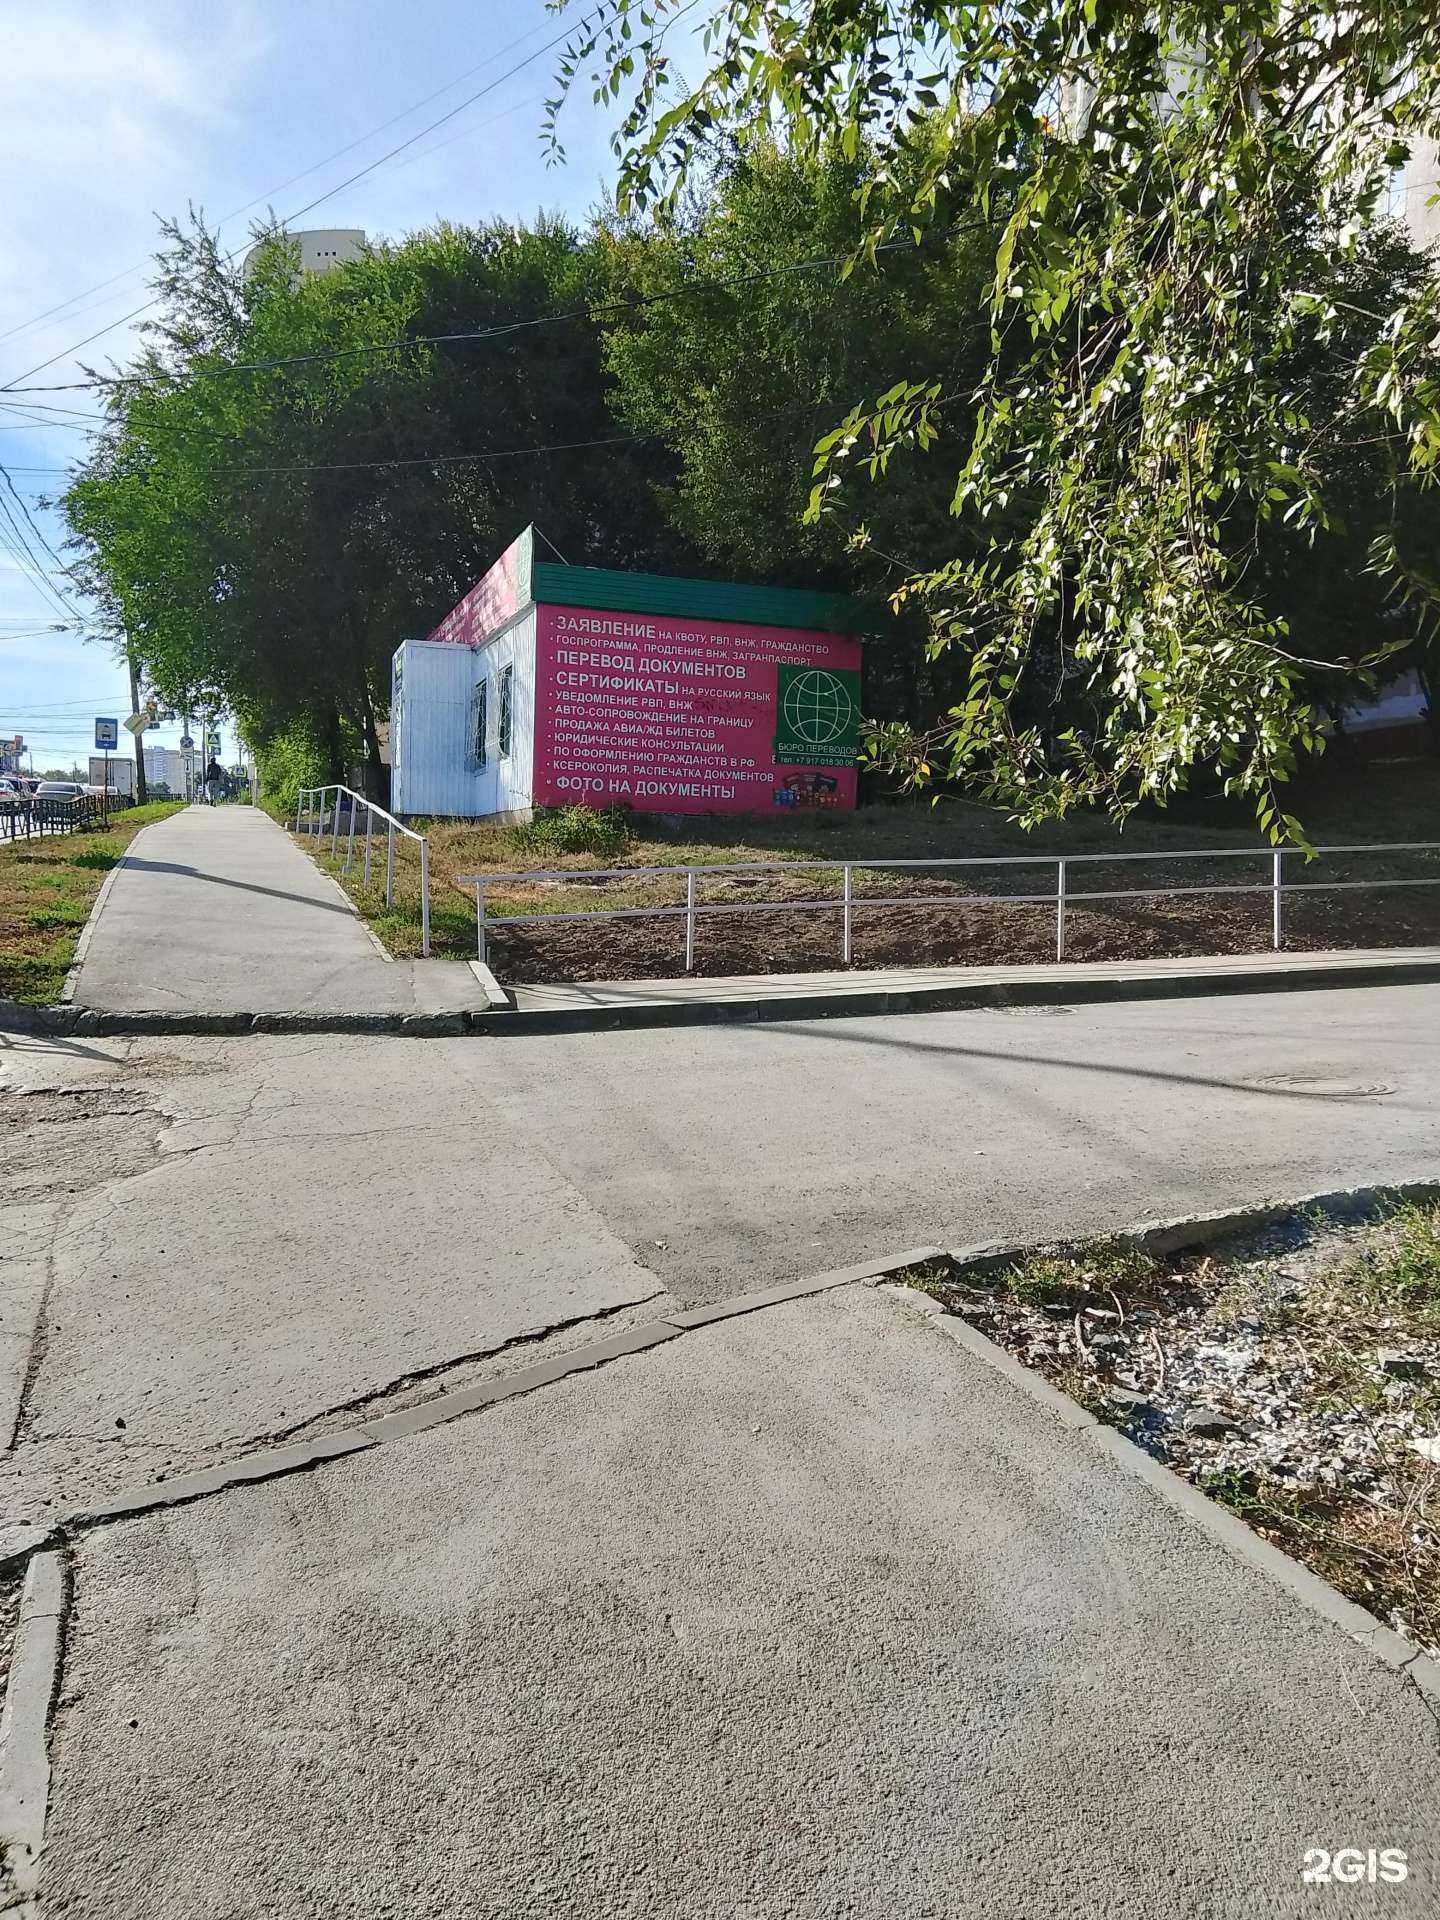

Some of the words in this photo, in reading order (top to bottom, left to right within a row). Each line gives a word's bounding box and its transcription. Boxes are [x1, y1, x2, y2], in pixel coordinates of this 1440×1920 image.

[556, 616, 656, 639] ЗАЯВЛЕНИЕ
[659, 631, 673, 640] НА
[675, 632, 708, 644] КВОТУ,
[710, 635, 732, 646] РВП,
[735, 638, 758, 649] ВНЖ,
[761, 639, 829, 655] ГРАЖДАНСТВО
[556, 635, 641, 652] ГОСПРОГРАММА,
[644, 643, 703, 657] ПРОДЛЕНИЕ
[706, 649, 730, 660] ВНЖ,
[732, 652, 811, 666] ЗАГРАНПАСПОРТ
[557, 650, 634, 672] ПЕРЕВОД
[639, 658, 746, 679] ДОКУМЕНТОВ
[556, 671, 679, 694] СЕРТИФИКАТЫ
[682, 686, 695, 695] НА
[698, 687, 741, 699] РУССКИЙ
[744, 691, 771, 701] ЯЗЫК
[555, 690, 638, 706] УВЕДОМЛЕНИЕ
[641, 698, 666, 709] РВП,
[669, 700, 693, 710] ВНЖ
[555, 704, 687, 723] АВТО-СОПРОВОЖДЕНИЕ
[690, 715, 704, 724] НА
[708, 716, 754, 728] ГРАНИЦУ
[555, 718, 610, 731] ПРОДАЖА
[613, 723, 663, 736] АВИА/ЖД
[665, 726, 715, 738] БИЛЕТОВ
[554, 732, 638, 747] ЮРИДИЧЕСКИЕ
[641, 738, 724, 752] КОНСУЛЬТАЦИИ
[778, 742, 804, 752] БЮРО
[806, 744, 857, 755] ПЕРЕВОДОВ
[554, 746, 569, 756] ПО
[573, 748, 654, 761] ОФОРМЛЕНИЮ
[657, 753, 727, 766] ГРАЖДАНСТВ
[740, 758, 755, 767] РФ
[553, 760, 630, 774] КСЕРОКОПИЯ,
[633, 765, 701, 778] РАСПЕЧАТКА
[704, 769, 774, 782] ДОКУМЕНТОВ
[556, 776, 604, 791] ФОТО
[609, 778, 631, 793] НА
[635, 780, 735, 798] ДОКУМЕНТЫ
